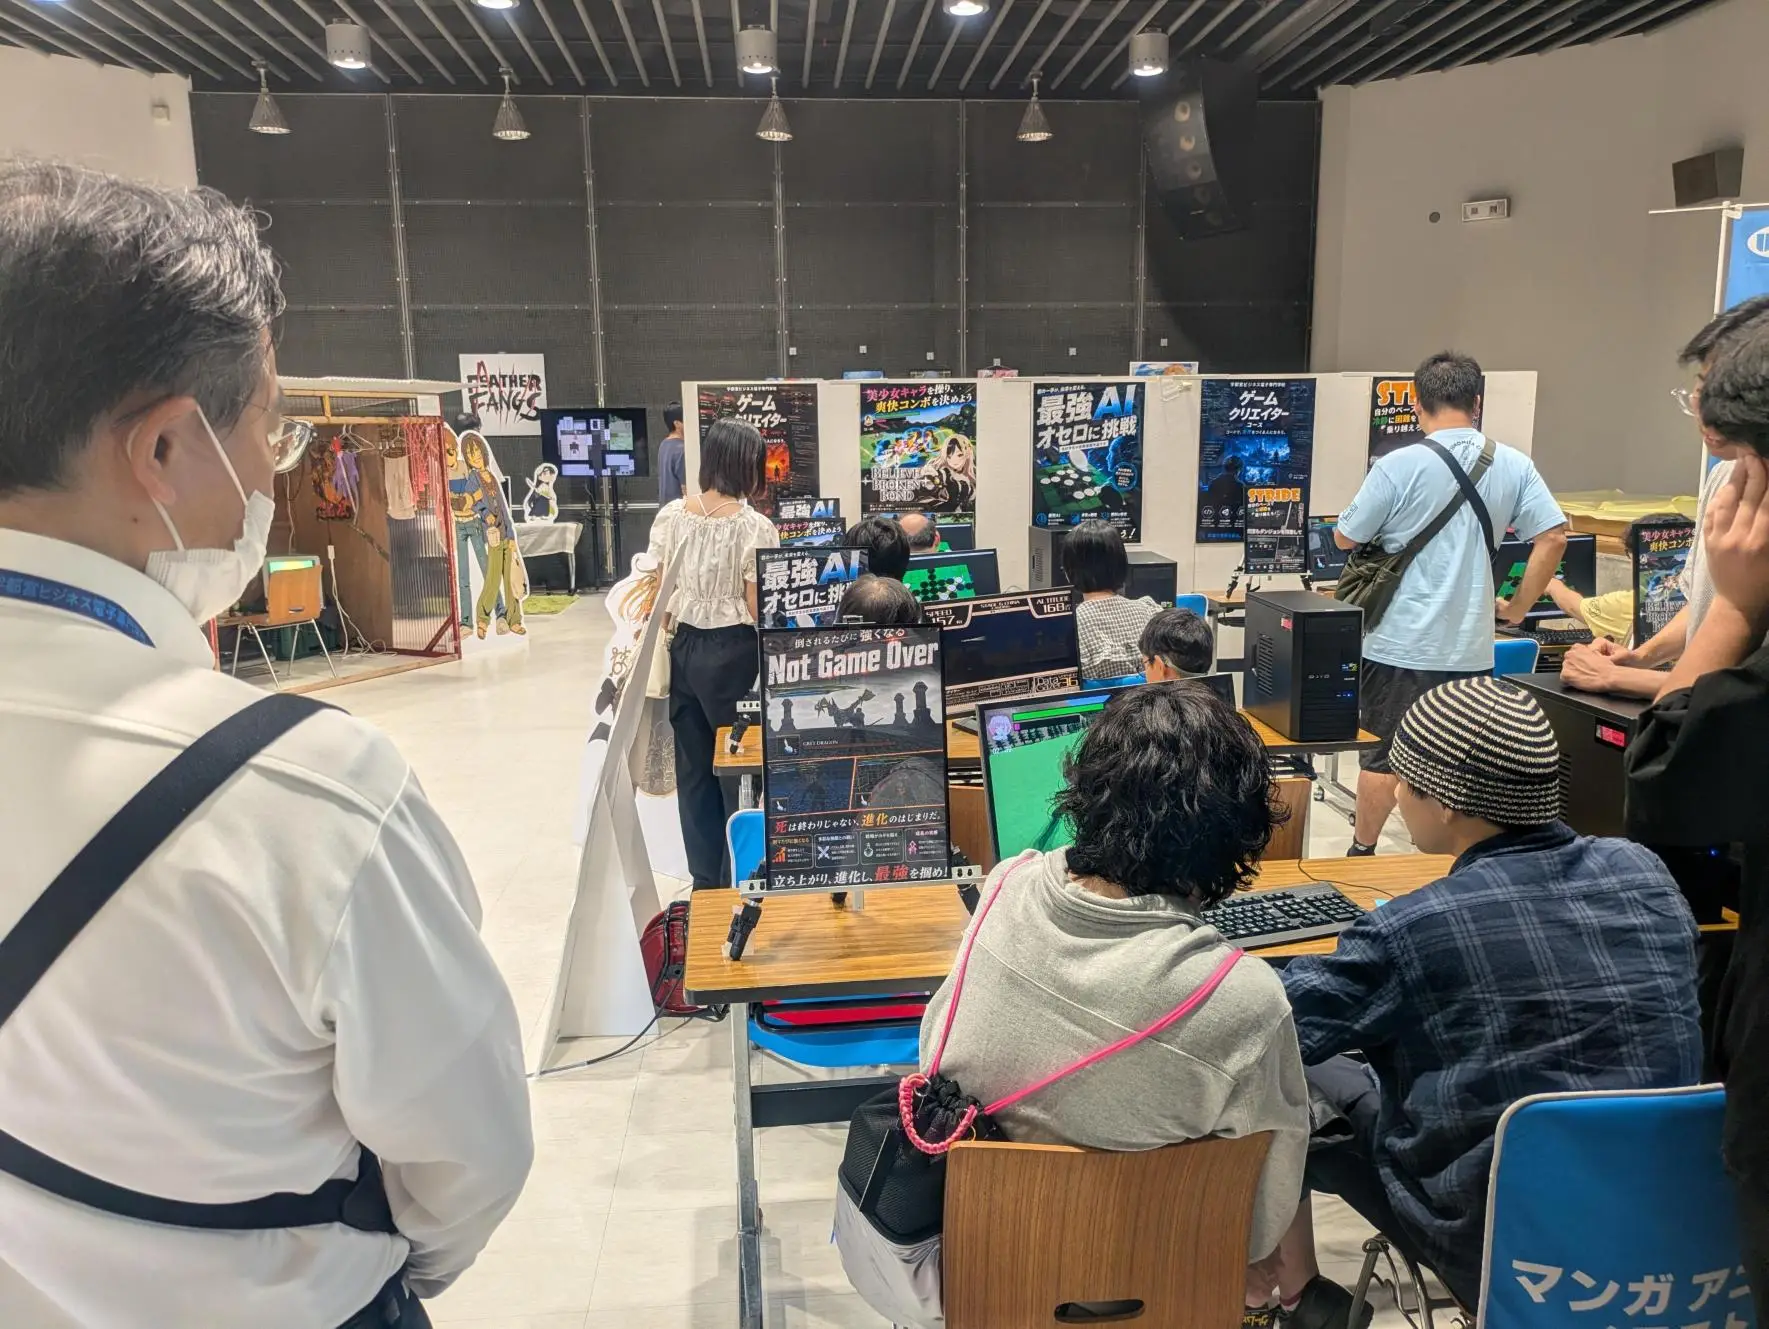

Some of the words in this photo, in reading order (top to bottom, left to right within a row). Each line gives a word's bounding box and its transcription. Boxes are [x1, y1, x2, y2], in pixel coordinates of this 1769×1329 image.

[468, 391, 543, 422] FANGS
[736, 393, 777, 412] ゲーム
[1239, 390, 1279, 406] ゲーム
[1228, 407, 1290, 421] クリエイター
[1036, 415, 1138, 449] オセロに挑戦
[1247, 487, 1301, 503] STRIDE
[762, 582, 850, 615] オセロに挑
[768, 653, 811, 686] Not
[818, 648, 881, 679] Game
[886, 640, 939, 670] Over
[1511, 1258, 1675, 1317] マンガ
